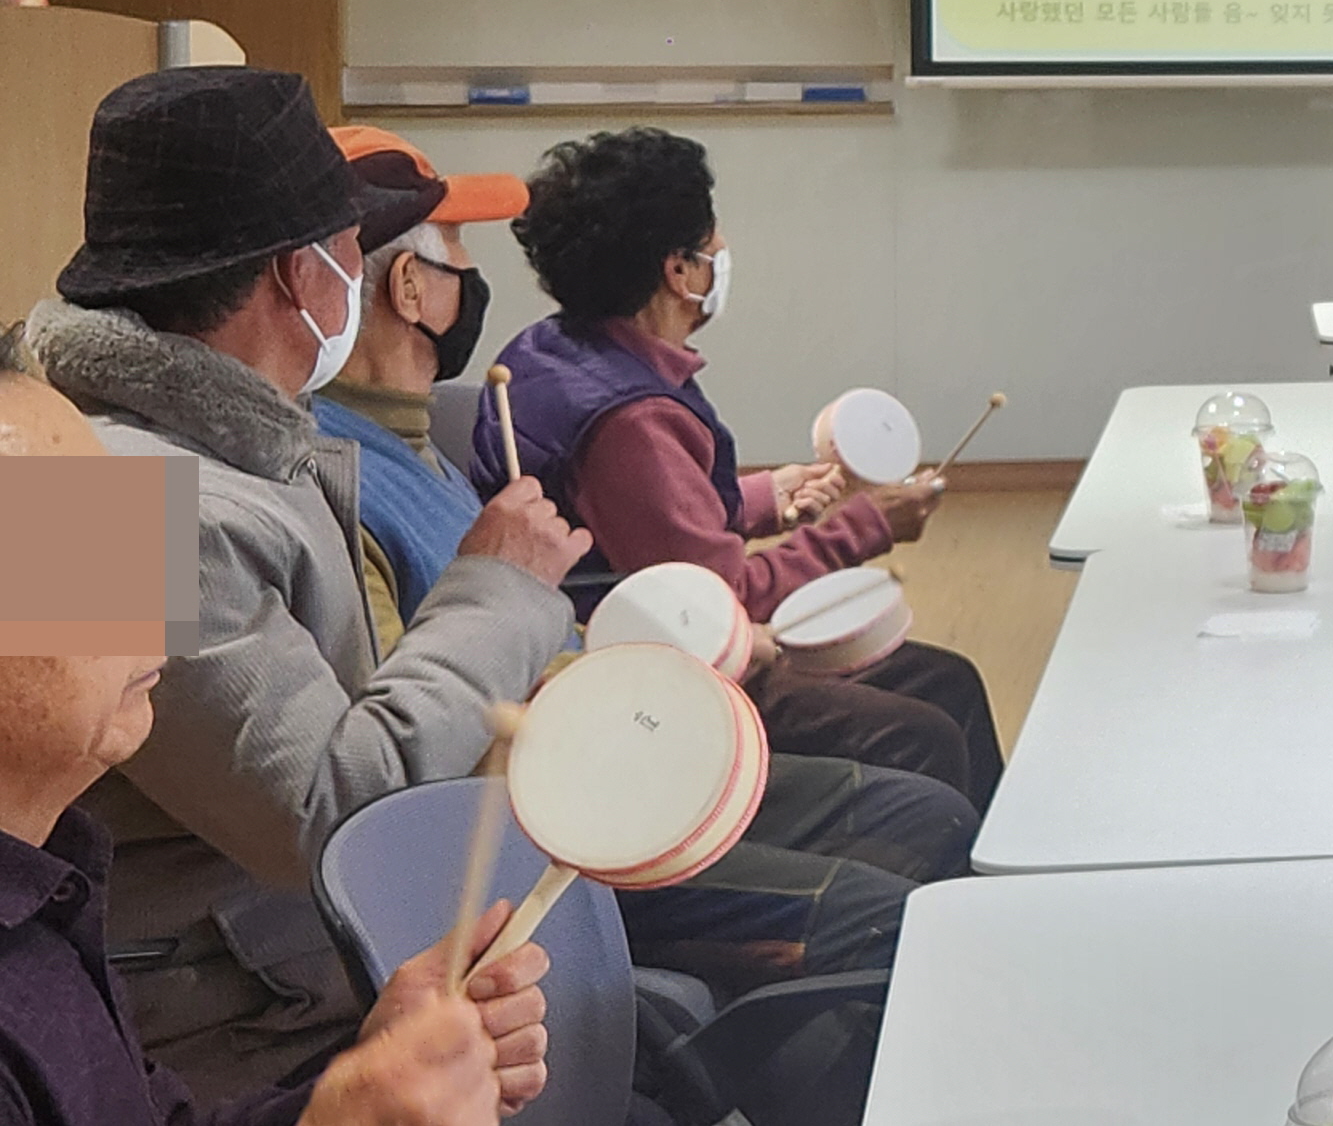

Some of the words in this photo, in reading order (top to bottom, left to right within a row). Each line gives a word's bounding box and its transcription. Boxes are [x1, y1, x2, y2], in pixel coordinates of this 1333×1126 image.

[996, 1, 1084, 23] 사랑했던
[1097, 1, 1137, 24] 모든
[1149, 2, 1213, 24] 사람들
[1270, 3, 1310, 24] 잊지
